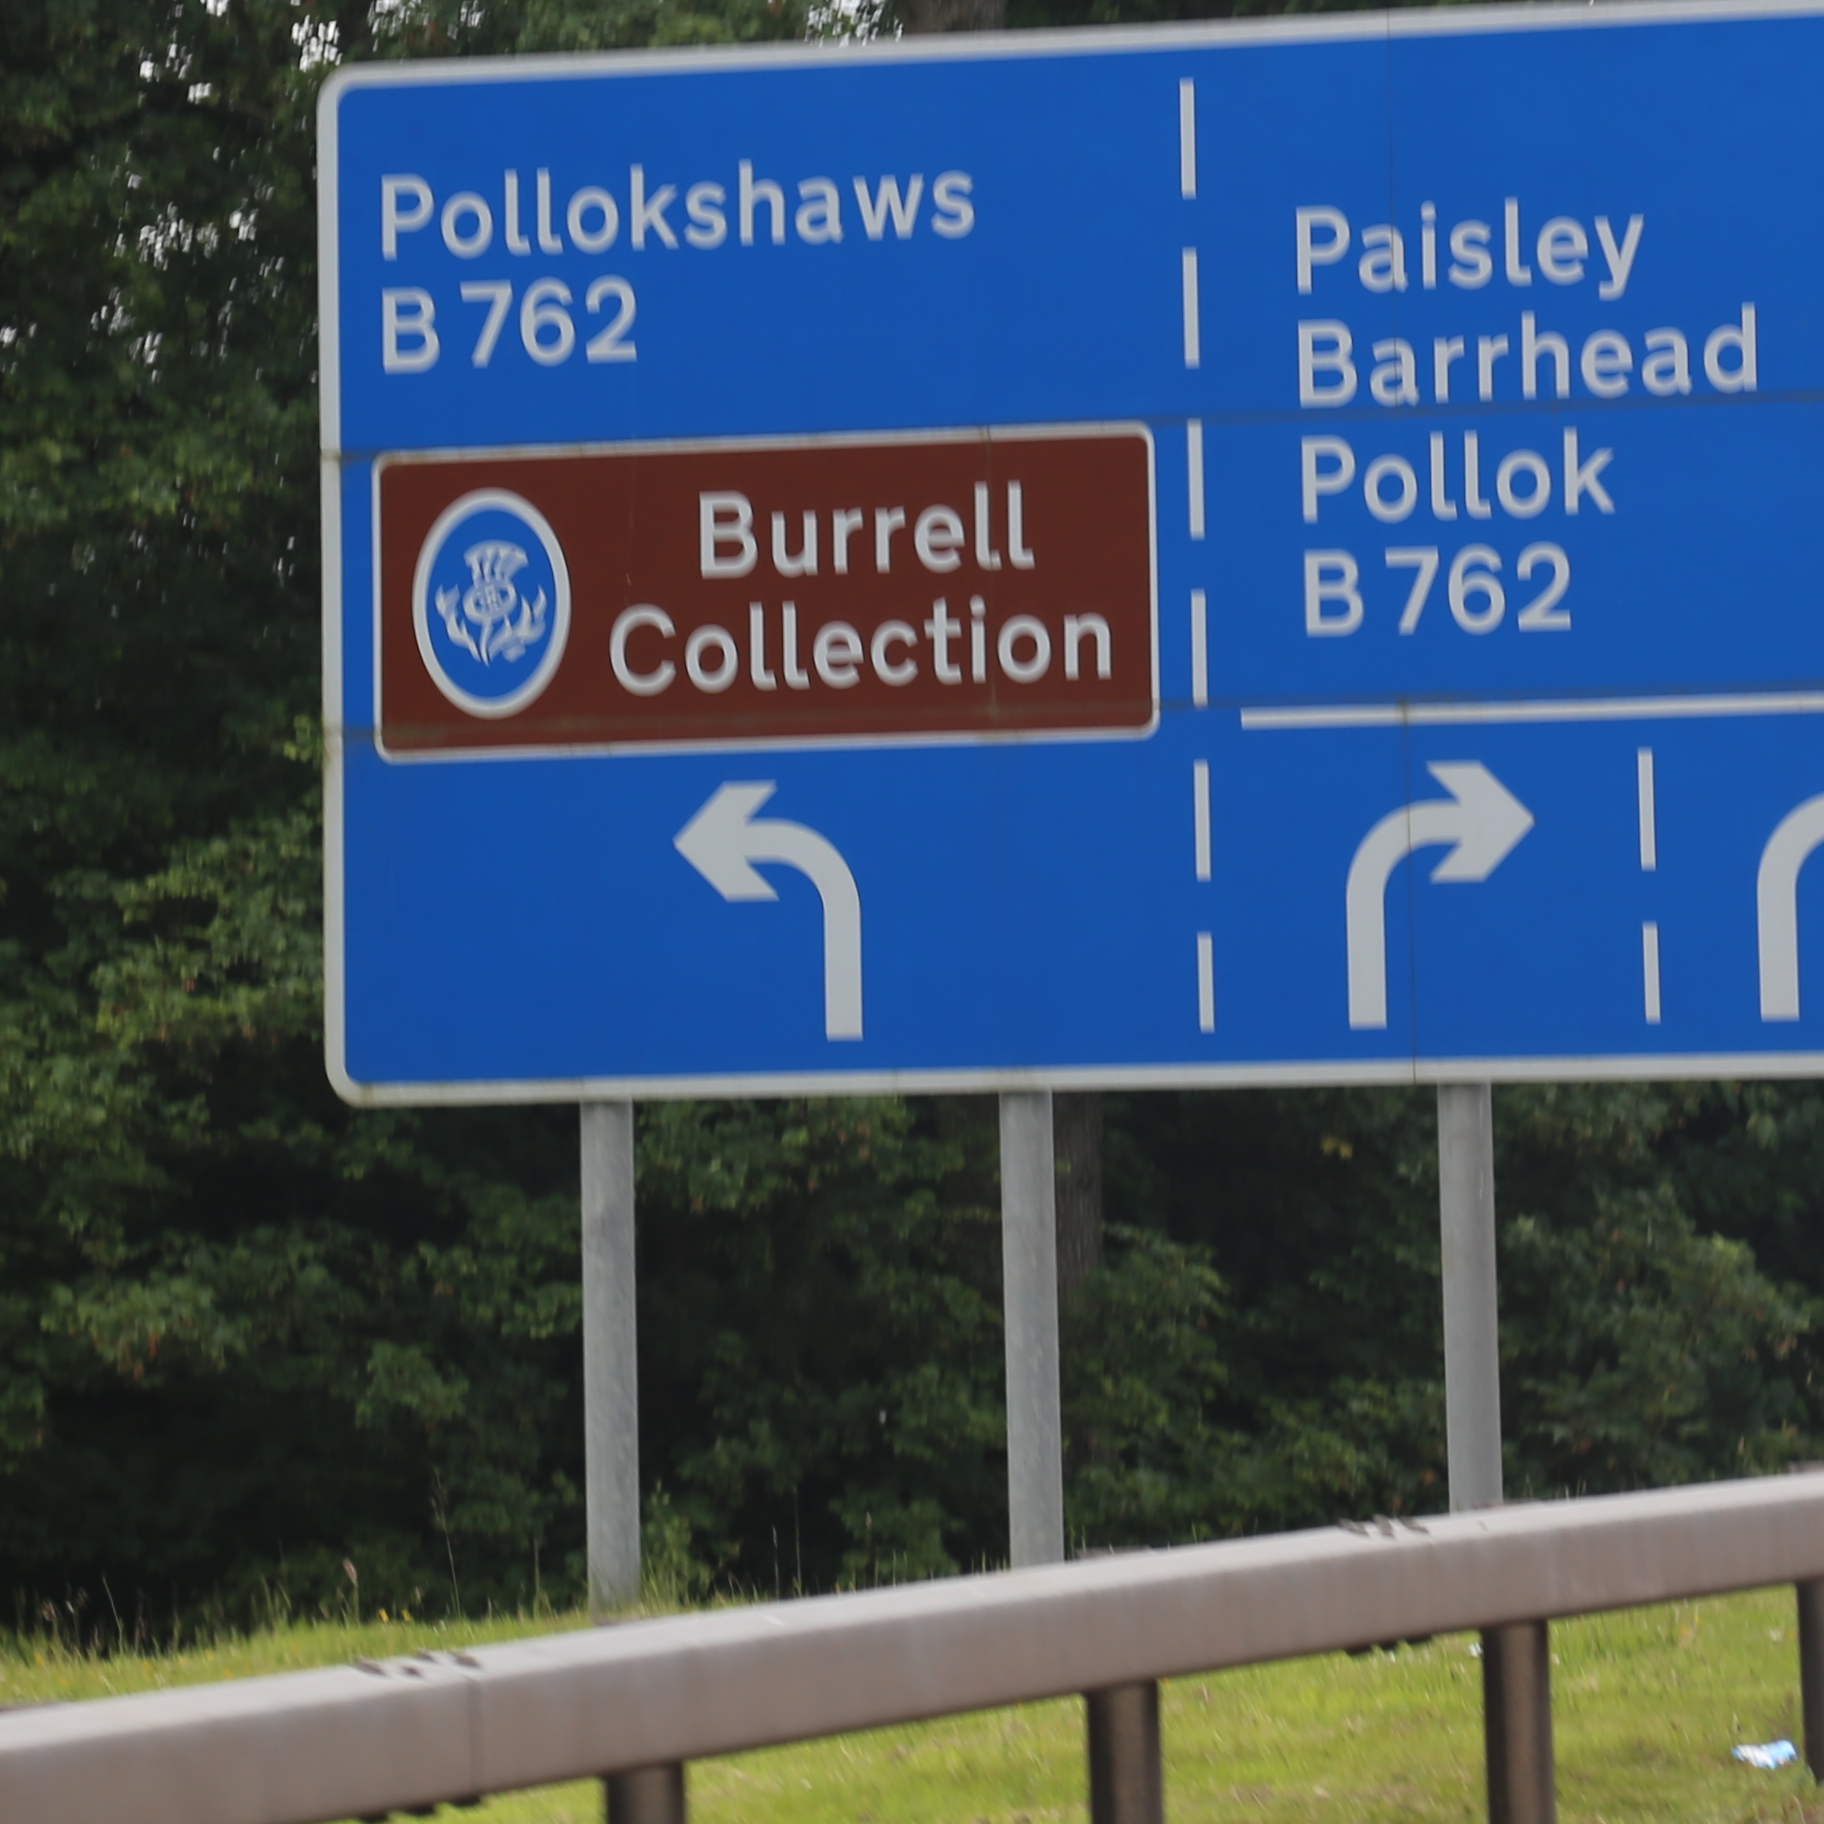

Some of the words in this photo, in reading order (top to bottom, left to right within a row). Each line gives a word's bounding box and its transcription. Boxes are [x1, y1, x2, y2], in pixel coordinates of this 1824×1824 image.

[381, 158, 975, 261] Pollokshaws
[1295, 196, 1644, 301] Paisley
[1297, 301, 1758, 409] Barrhead
[1300, 425, 1616, 525] Pollok
[699, 480, 1036, 579] Burrell
[609, 594, 1112, 697] Collection
